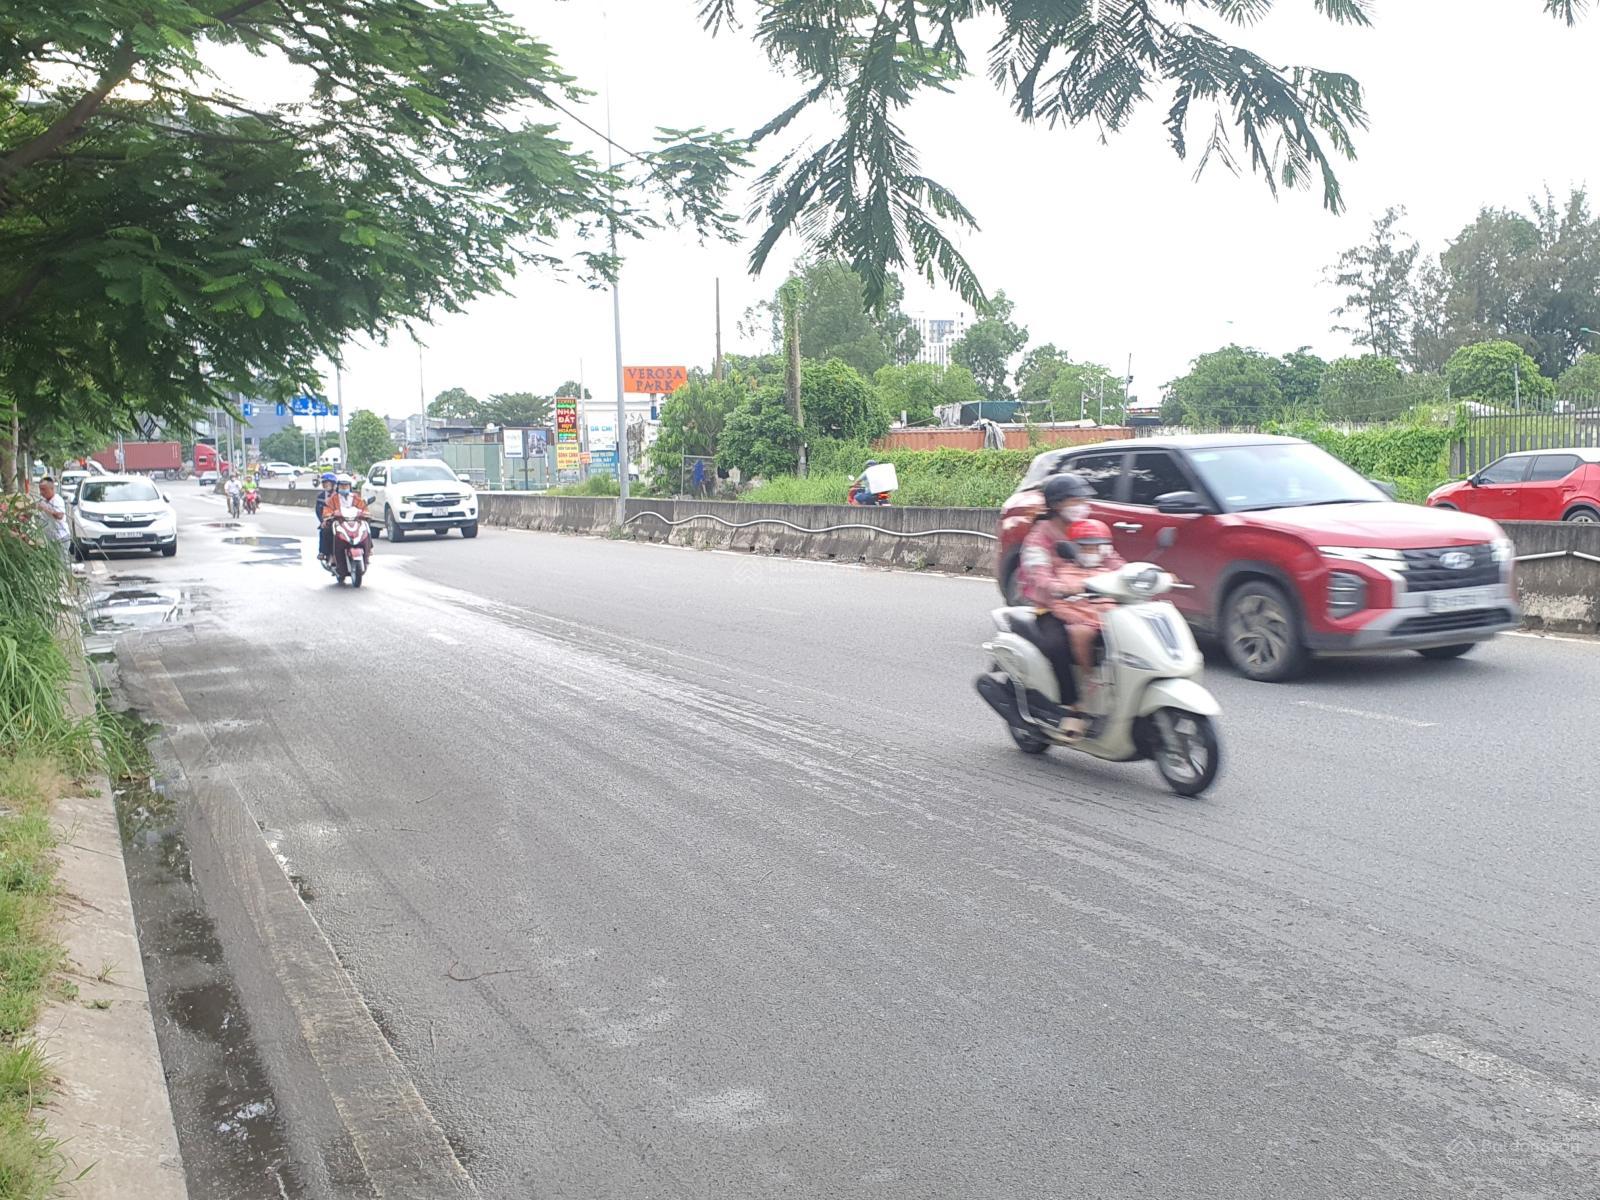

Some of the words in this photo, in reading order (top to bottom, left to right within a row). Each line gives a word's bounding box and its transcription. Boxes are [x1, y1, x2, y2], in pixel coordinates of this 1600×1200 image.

[627, 368, 683, 379] VEROSA
[636, 380, 674, 391] PARK
[558, 406, 576, 415] NHÀ
